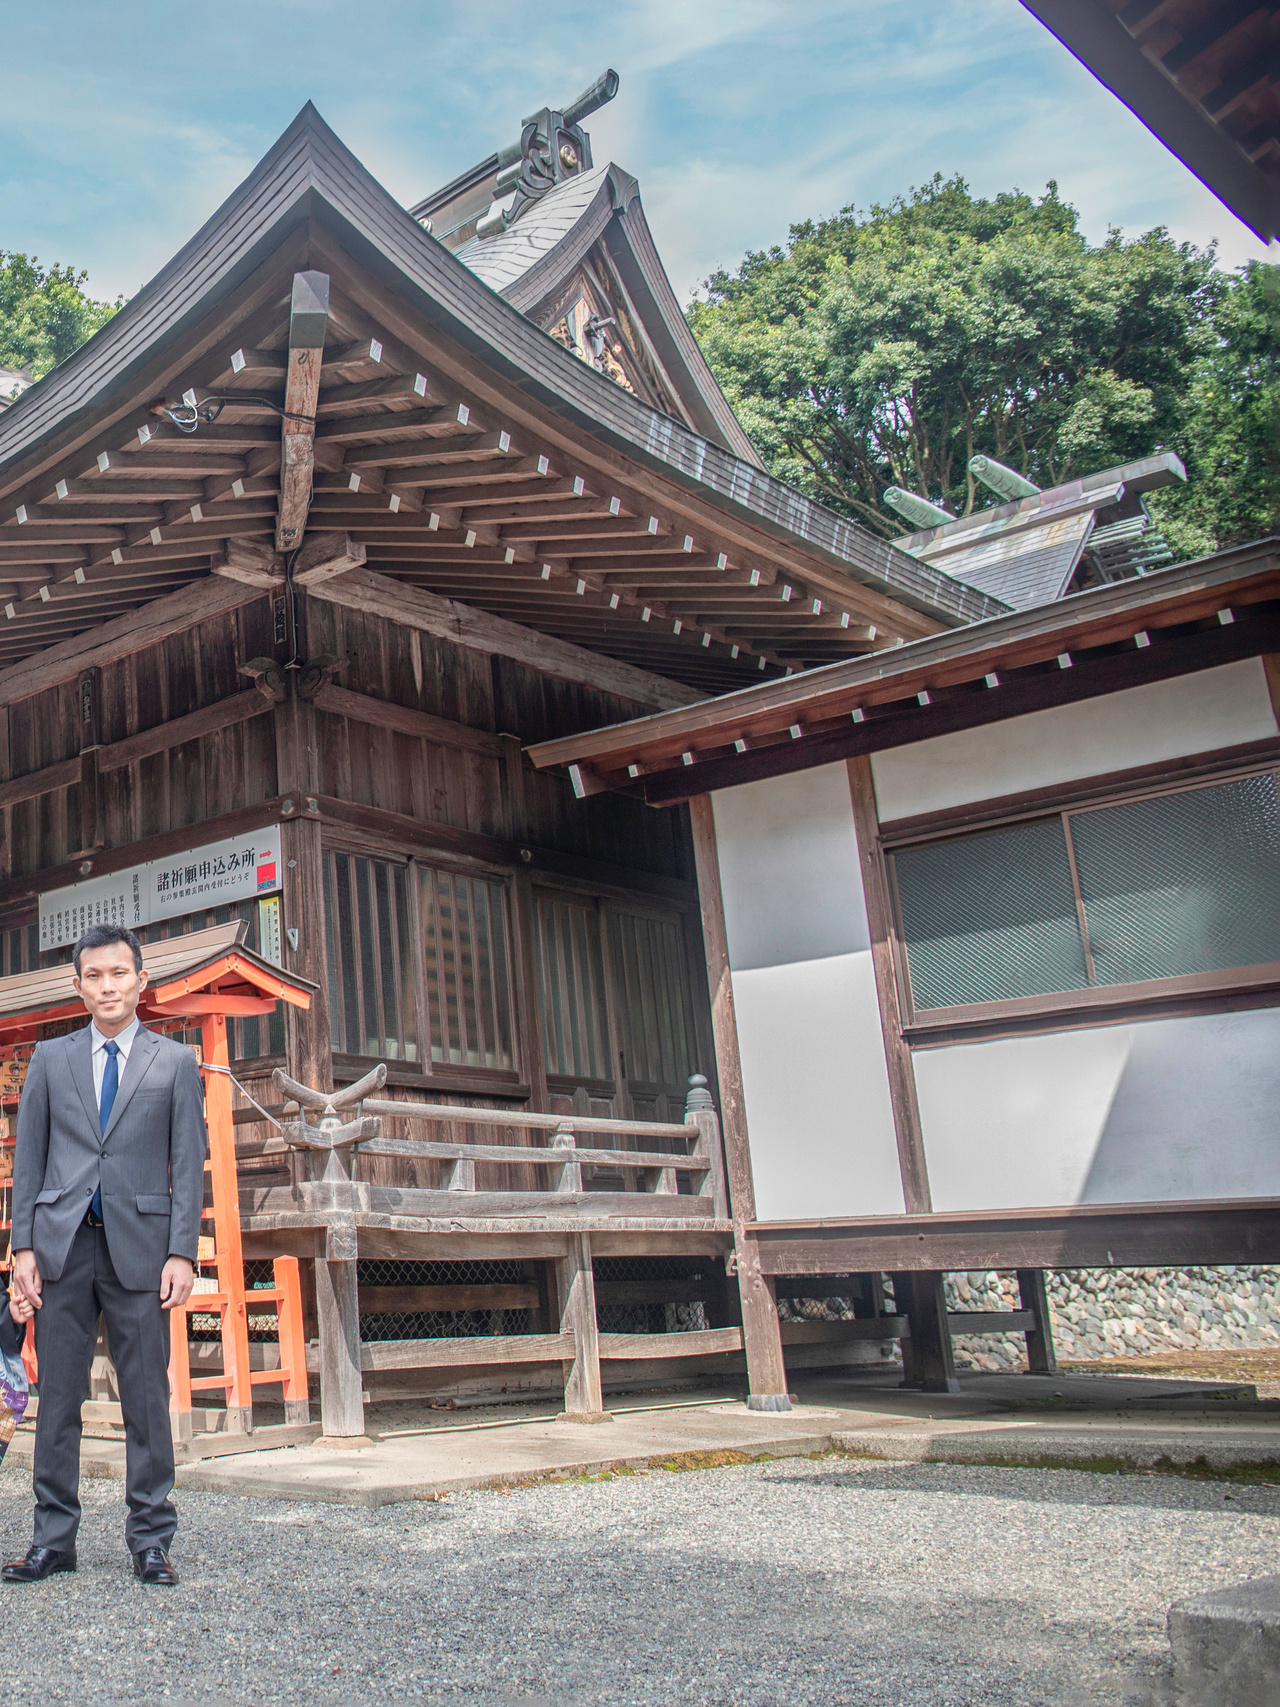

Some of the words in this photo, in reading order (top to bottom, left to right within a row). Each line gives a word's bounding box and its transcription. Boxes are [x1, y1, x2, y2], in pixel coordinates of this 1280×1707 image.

[157, 847, 255, 892] 諸祈願申込み所
[257, 879, 276, 890] SECOM
